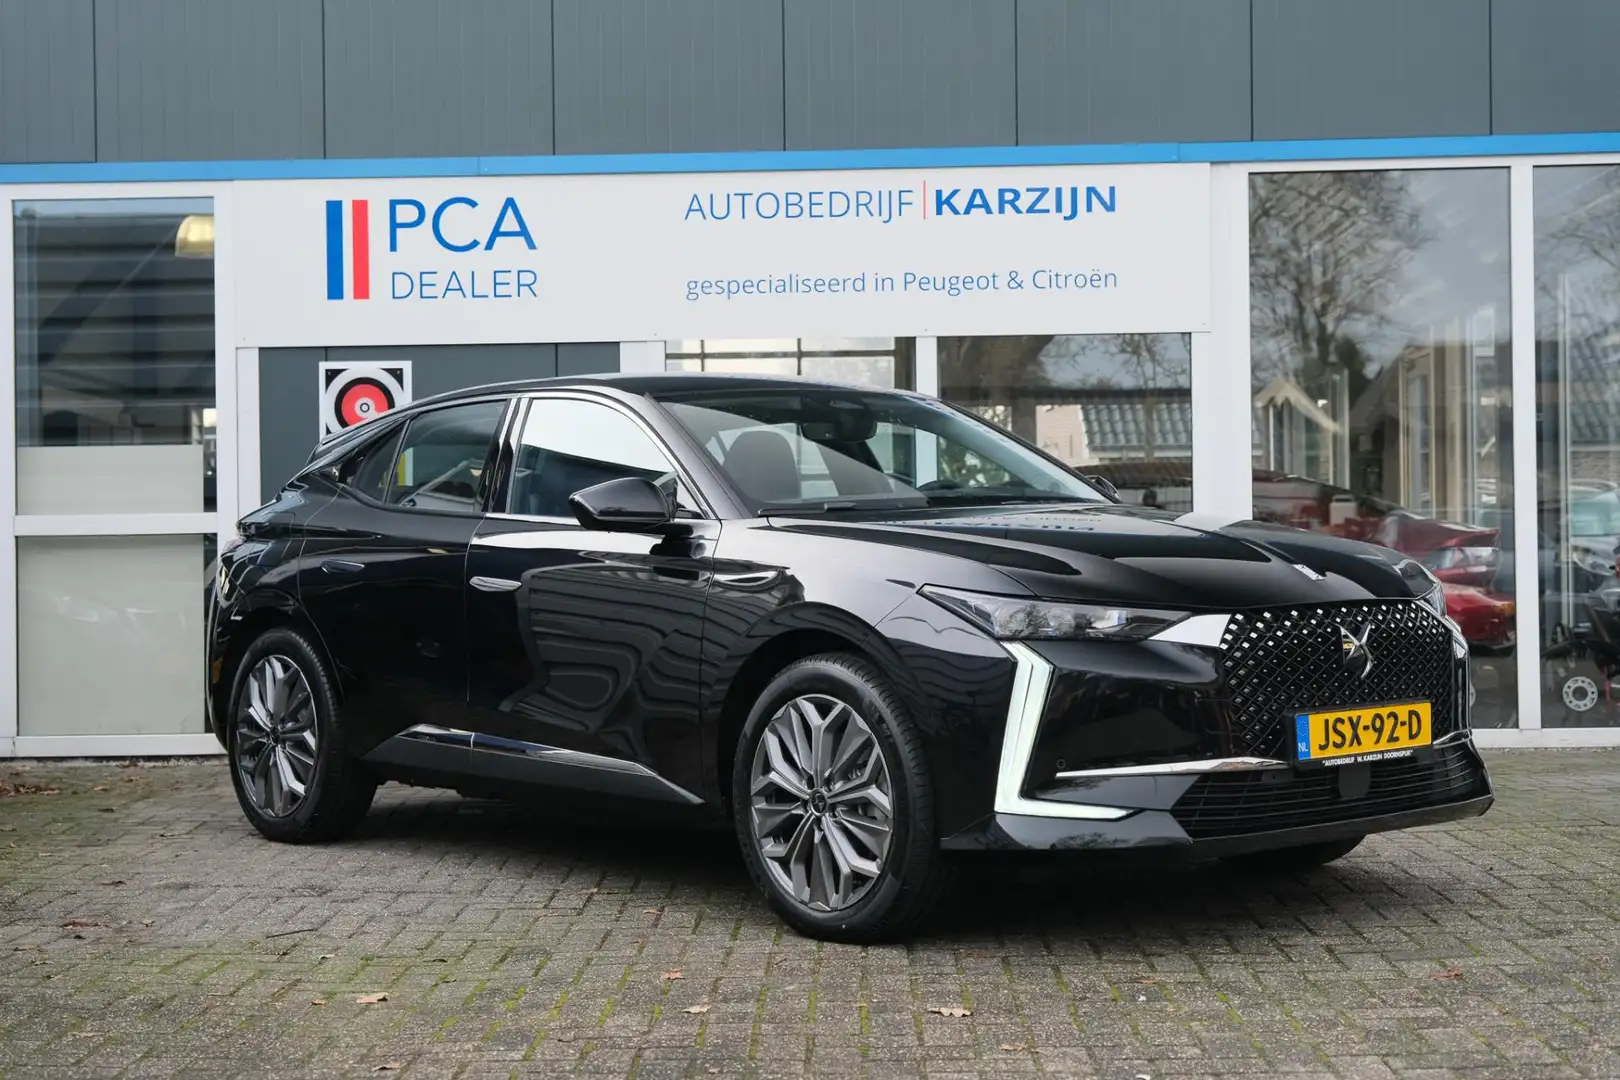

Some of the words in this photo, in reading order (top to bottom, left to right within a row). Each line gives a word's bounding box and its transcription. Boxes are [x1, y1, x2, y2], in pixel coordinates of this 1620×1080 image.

[684, 189, 914, 224] AUTOBEDRIJF
[935, 185, 1117, 221] KARZIJN
[388, 196, 538, 253] PCA
[391, 269, 538, 300] DEALER
[686, 271, 866, 301] gespecialiseerd
[873, 273, 895, 293] in
[903, 270, 999, 298] Peugeot
[1006, 270, 1025, 291] &
[1031, 268, 1118, 291] Citroën
[1298, 742, 1309, 753] NL
[1318, 709, 1422, 751] JSX-92-D
